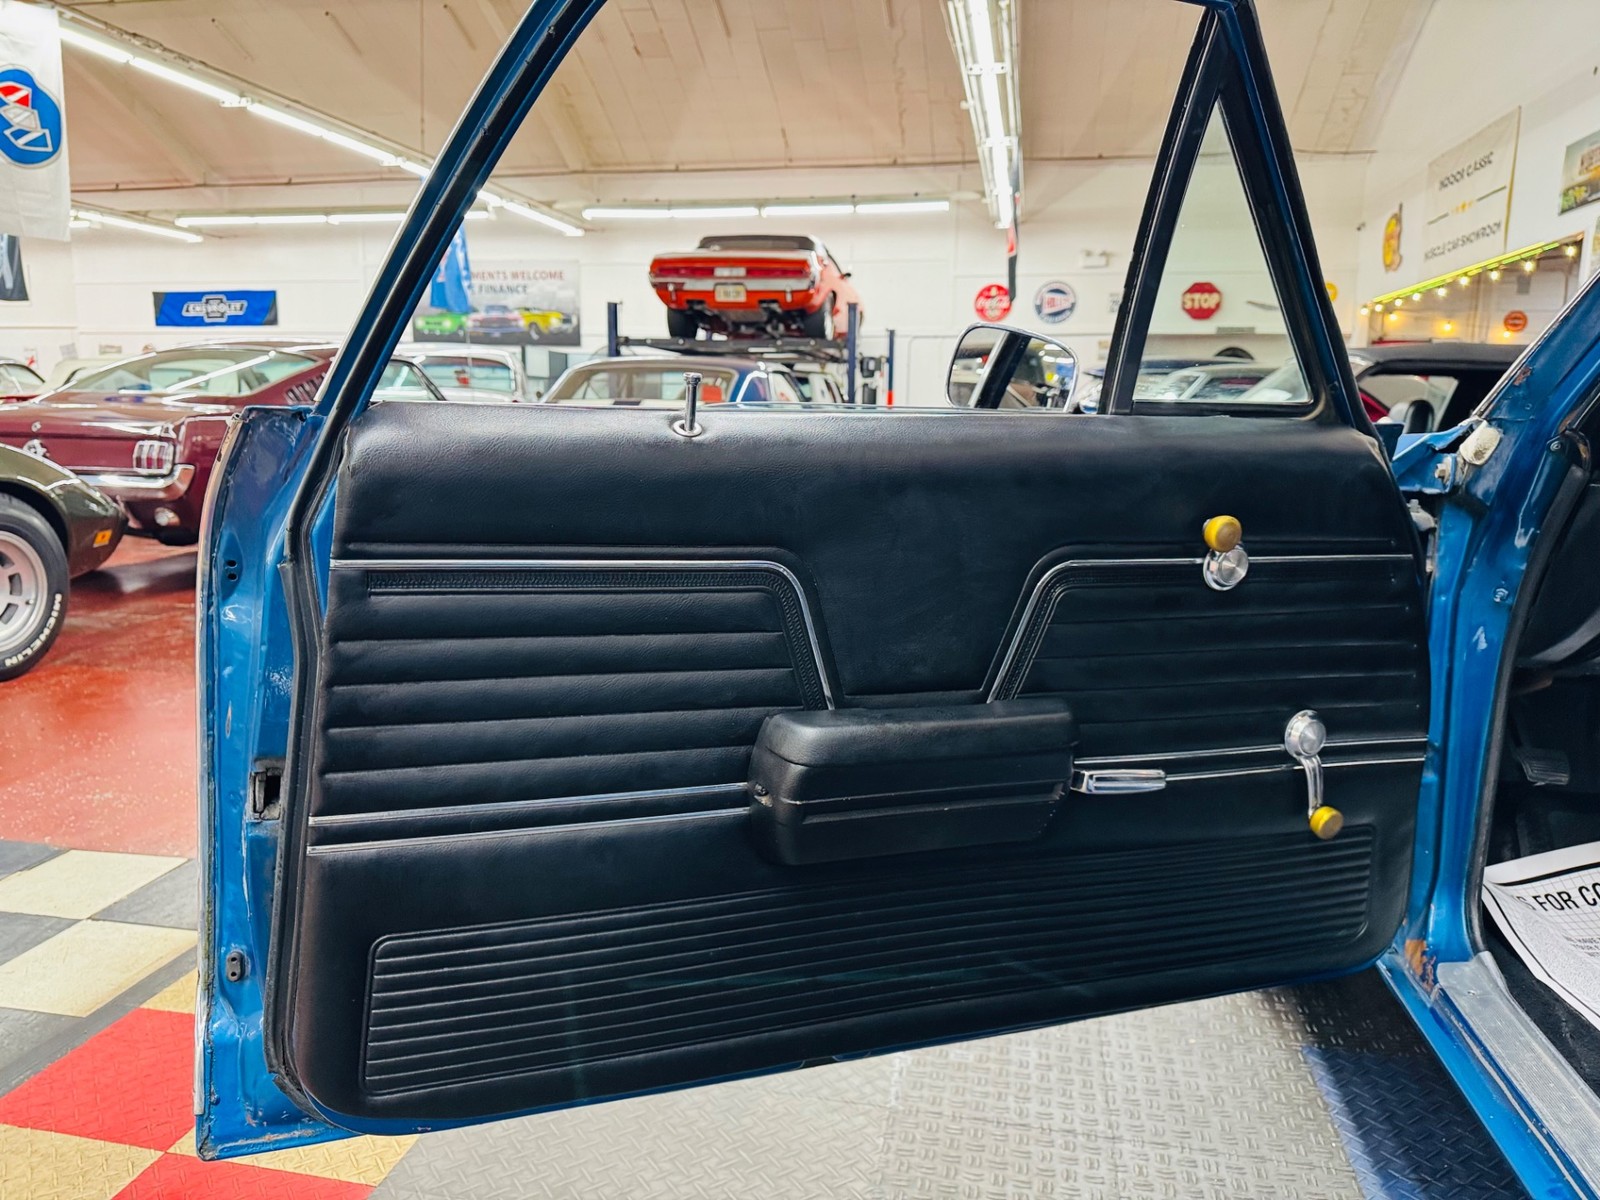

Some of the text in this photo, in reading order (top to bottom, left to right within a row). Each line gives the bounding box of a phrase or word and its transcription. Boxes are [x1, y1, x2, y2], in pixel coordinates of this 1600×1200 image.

[471, 270, 565, 281] MENTS WELCOME
[479, 284, 528, 294] FINANCE
[1183, 293, 1220, 309] STOP
[5, 593, 62, 667] MICHELIN
[1532, 891, 1580, 912] FOR
